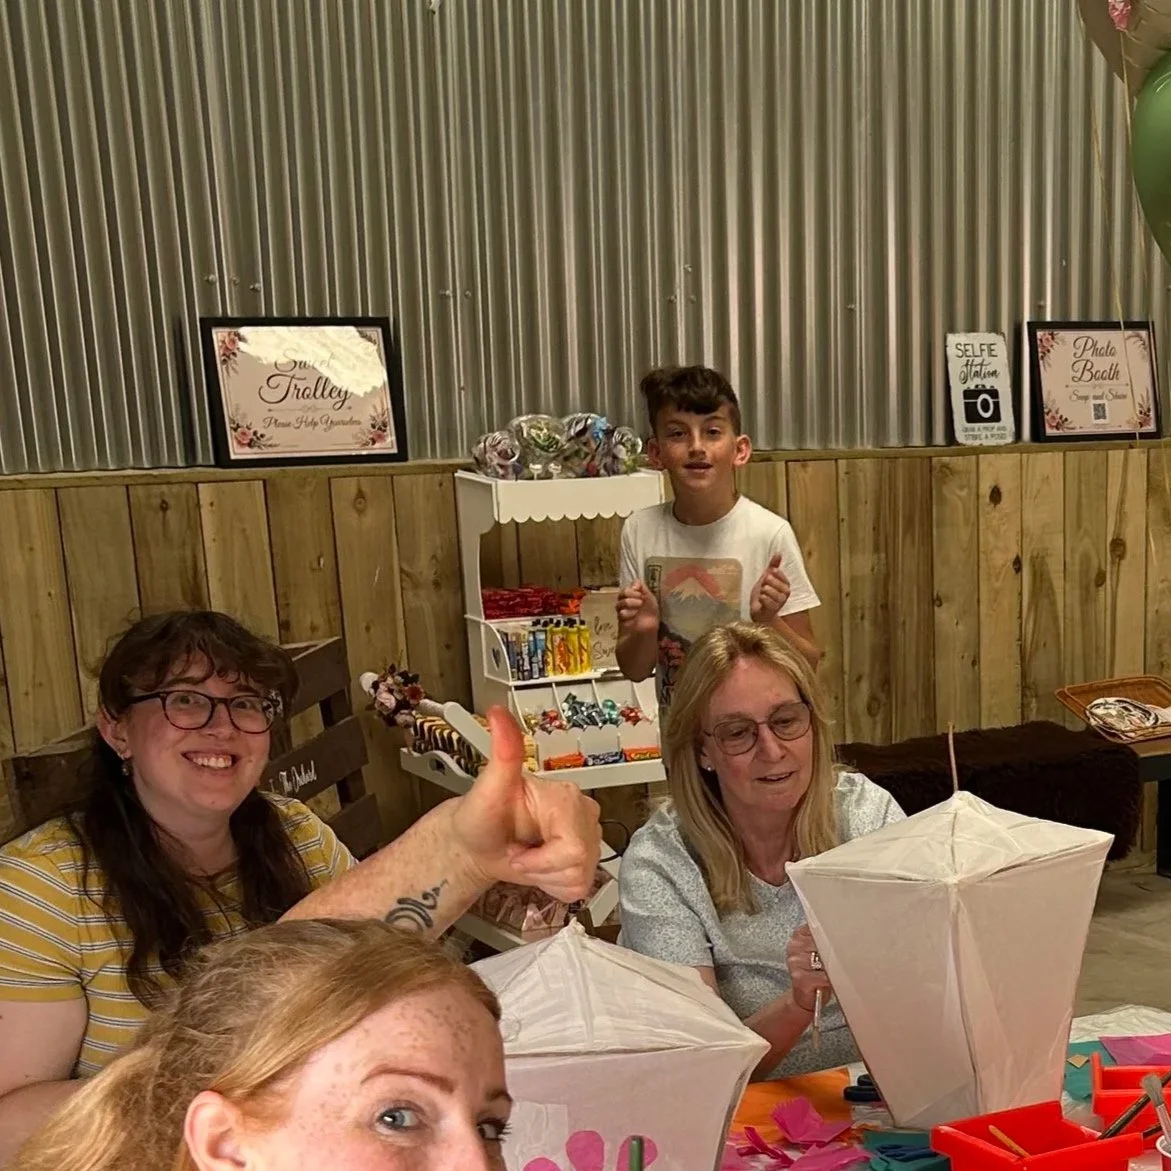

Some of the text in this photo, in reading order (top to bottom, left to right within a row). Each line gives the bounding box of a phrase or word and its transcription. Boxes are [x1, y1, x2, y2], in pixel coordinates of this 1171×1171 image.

[955, 343, 997, 358] SELFIE
[1073, 336, 1117, 358] Photo
[959, 359, 1000, 384] Station
[1071, 359, 1120, 383] Booth
[258, 373, 352, 411] Trolley
[1092, 391, 1105, 400] and
[262, 416, 291, 429] Please
[293, 415, 319, 430] Help
